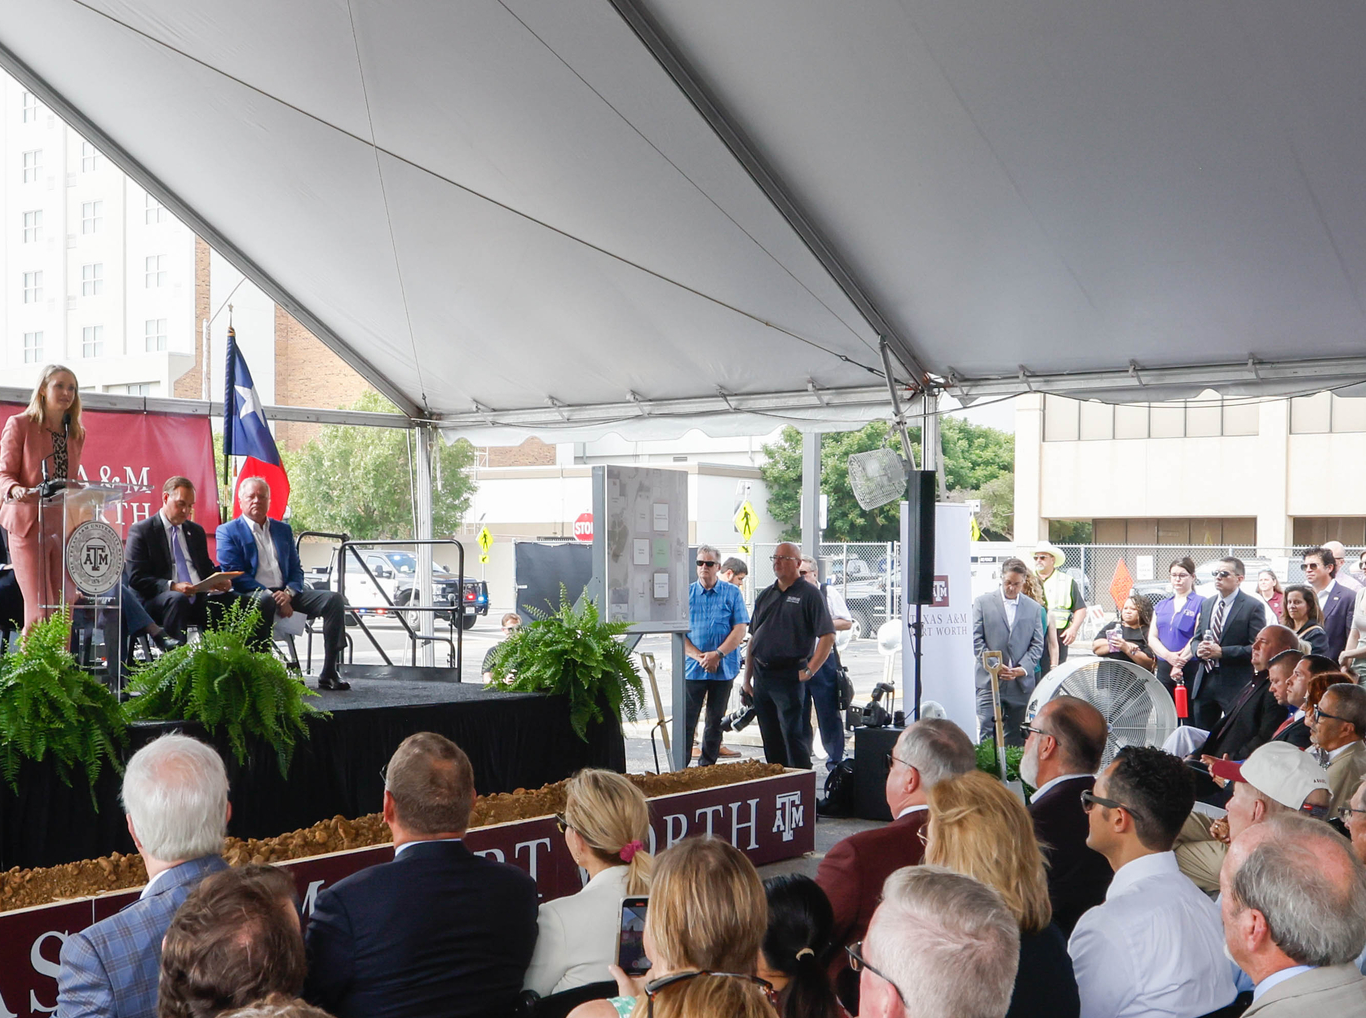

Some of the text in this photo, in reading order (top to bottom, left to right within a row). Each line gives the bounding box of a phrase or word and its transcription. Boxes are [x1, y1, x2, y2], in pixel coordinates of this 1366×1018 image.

[575, 521, 593, 535] STO
[910, 613, 967, 624] TXAS A&M
[936, 626, 968, 636] WORTH
